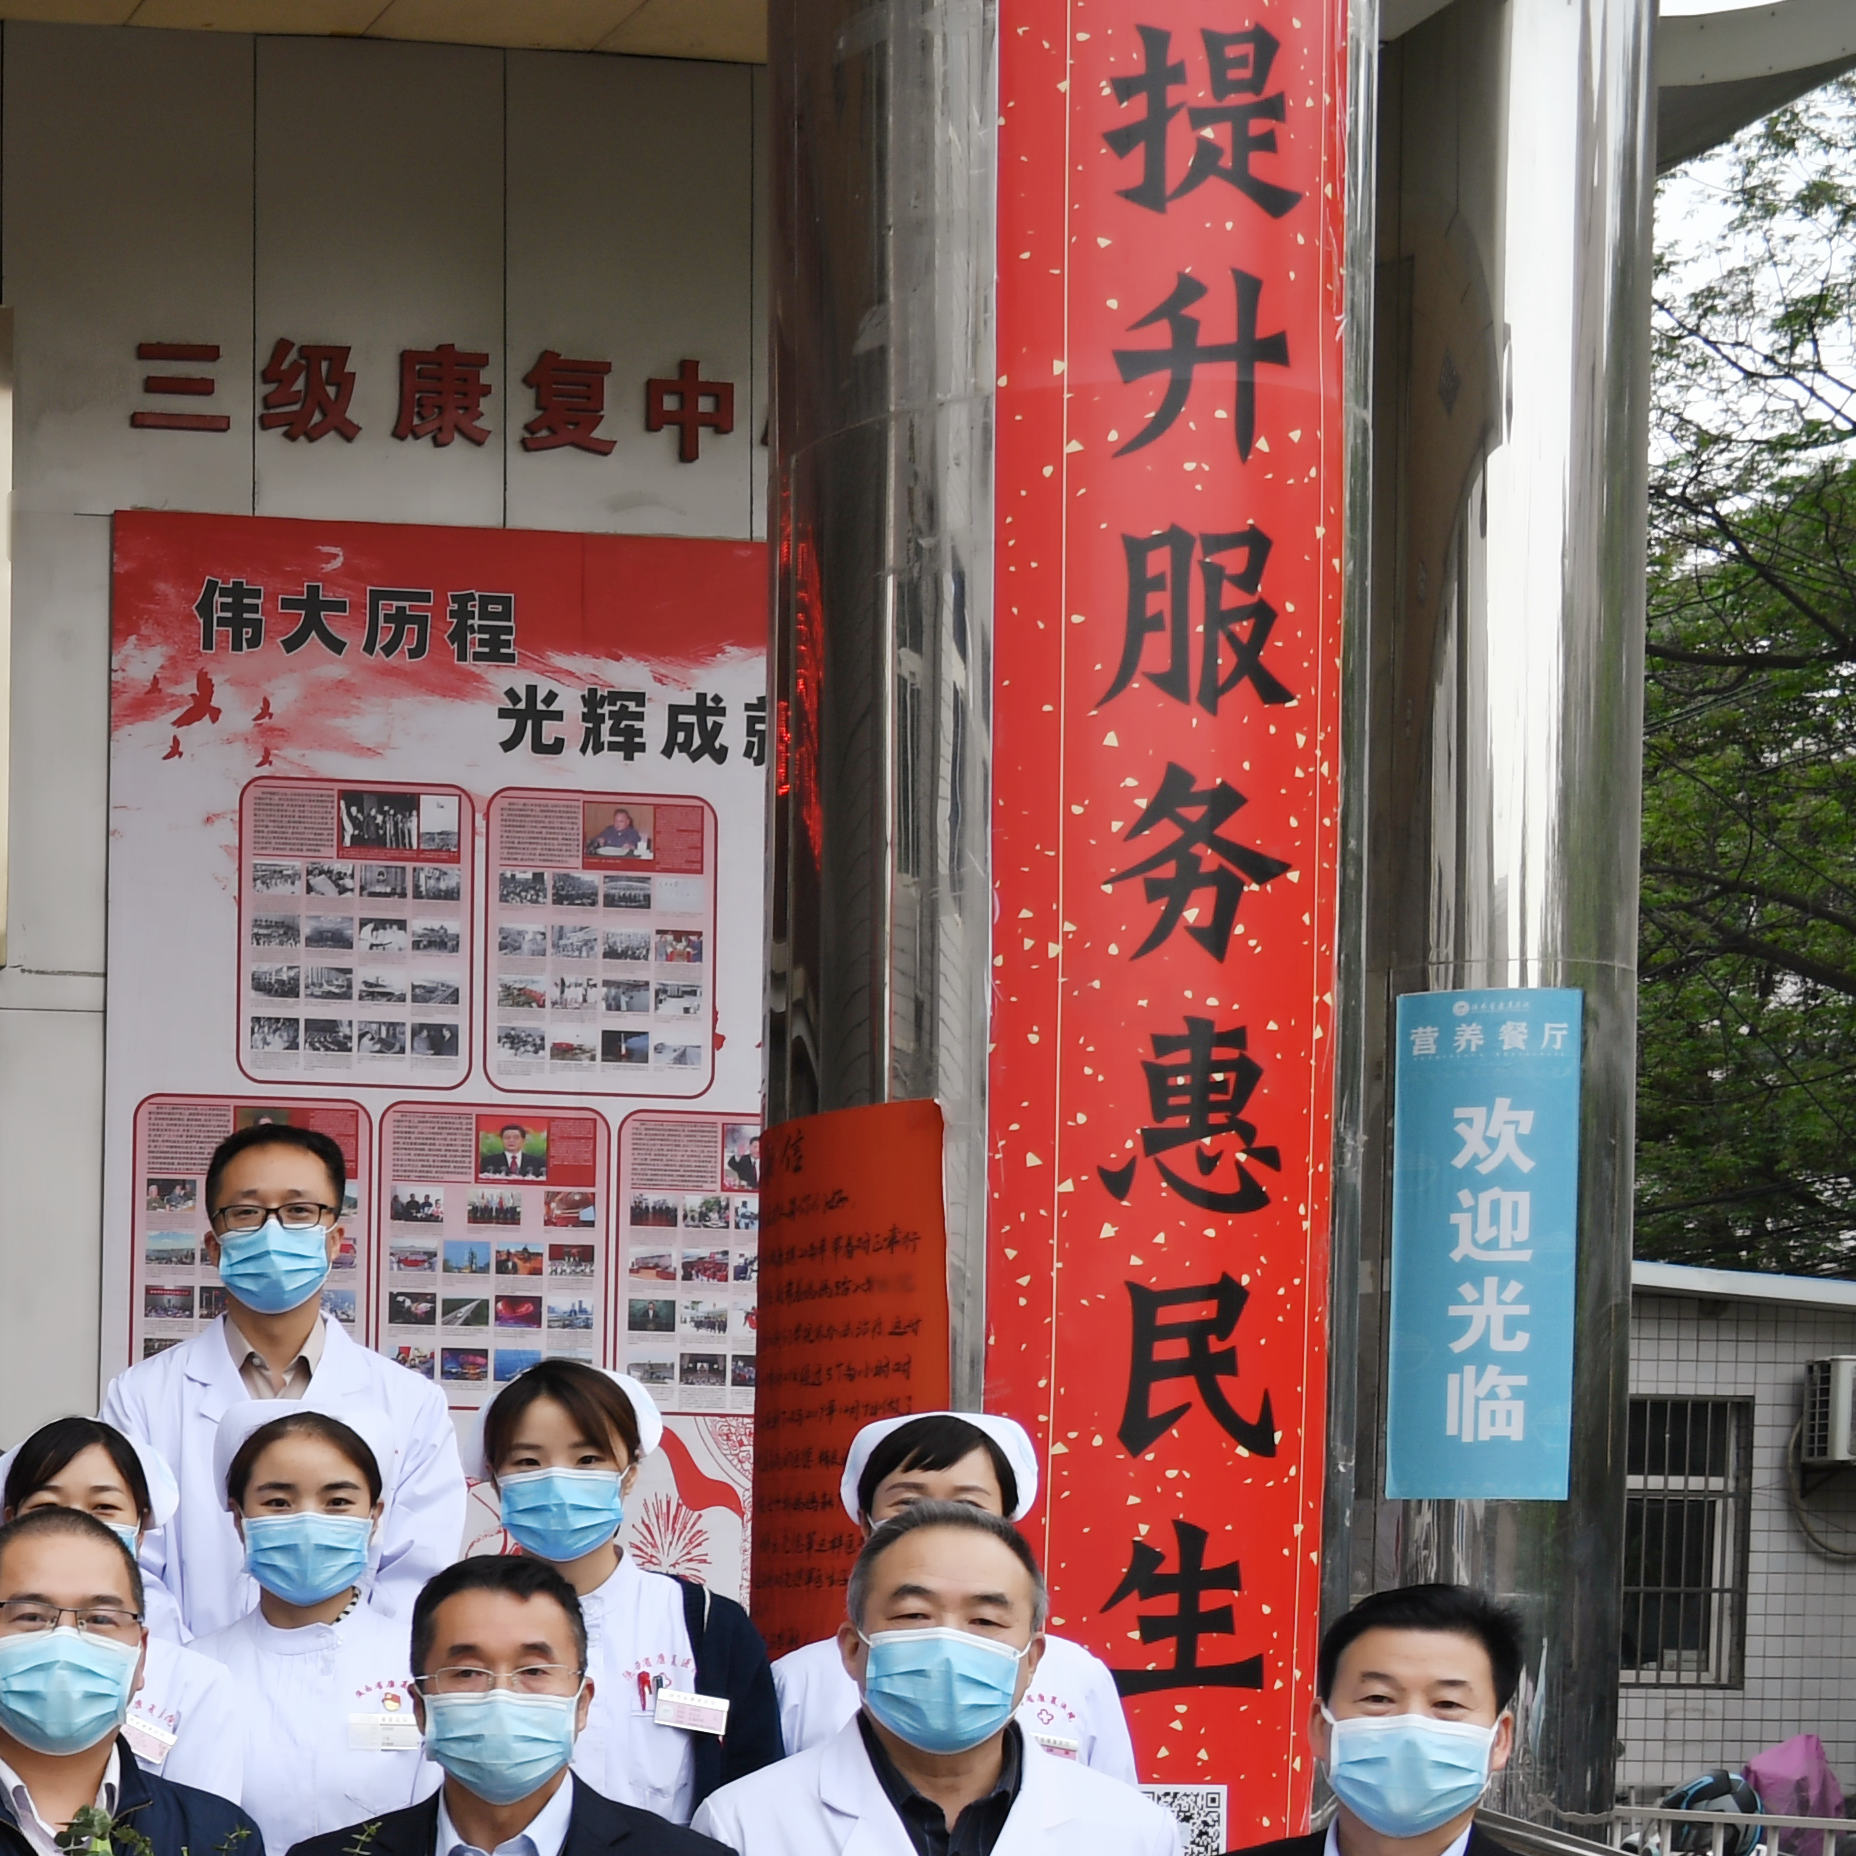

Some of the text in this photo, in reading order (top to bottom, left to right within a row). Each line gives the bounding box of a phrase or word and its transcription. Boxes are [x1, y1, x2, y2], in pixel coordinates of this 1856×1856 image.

[131, 338, 769, 463] 三级康复中
[193, 576, 519, 665] 伟大历程
[1095, 23, 1302, 1695] 提升服务惠民生
[1410, 1021, 1569, 1056] 营养餐厅
[1444, 1097, 1536, 1443] 欢迎光临
